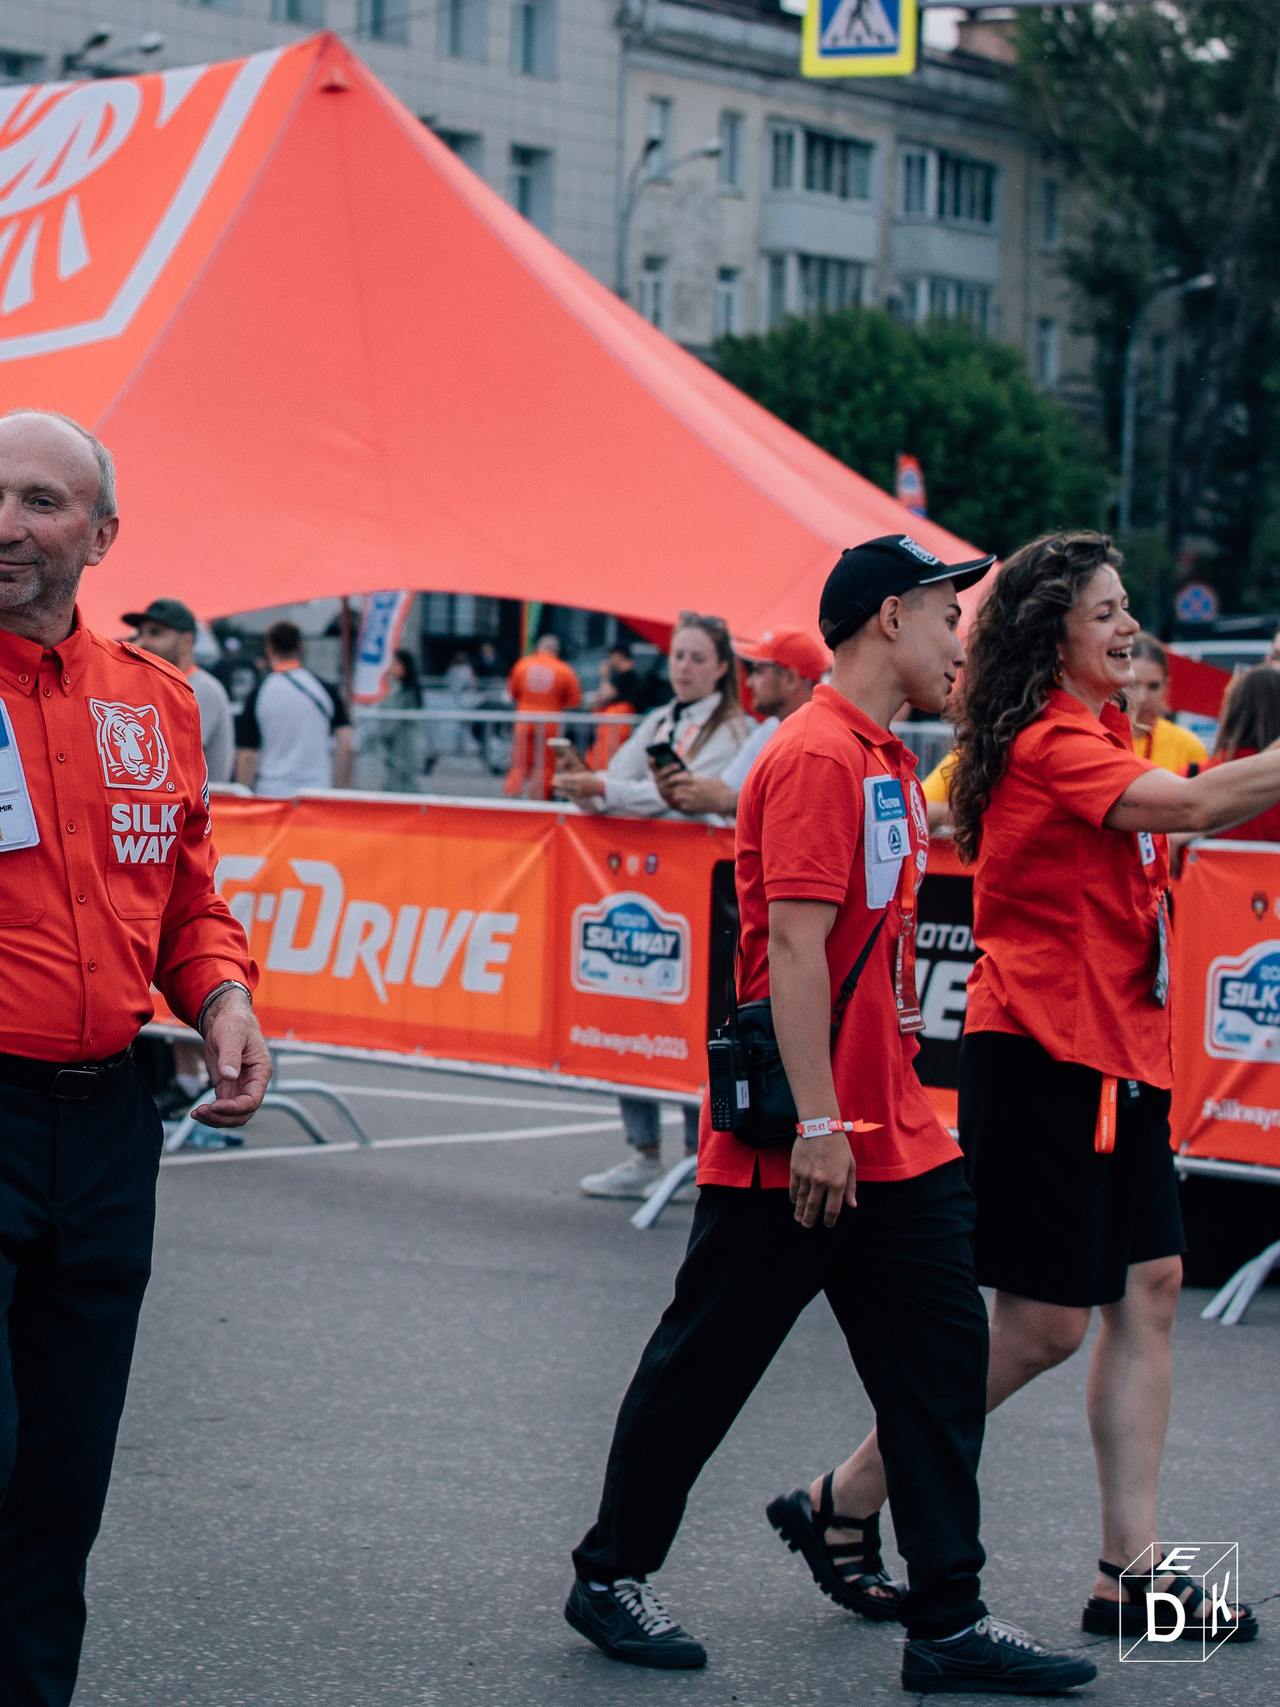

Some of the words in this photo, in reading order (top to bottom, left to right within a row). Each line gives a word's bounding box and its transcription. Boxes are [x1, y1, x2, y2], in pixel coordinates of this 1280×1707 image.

[111, 803, 181, 833] SILK
[112, 835, 176, 863] WAY
[585, 925, 630, 950] SILK
[631, 930, 677, 956] WAY
[1222, 980, 1280, 1011] SILK
